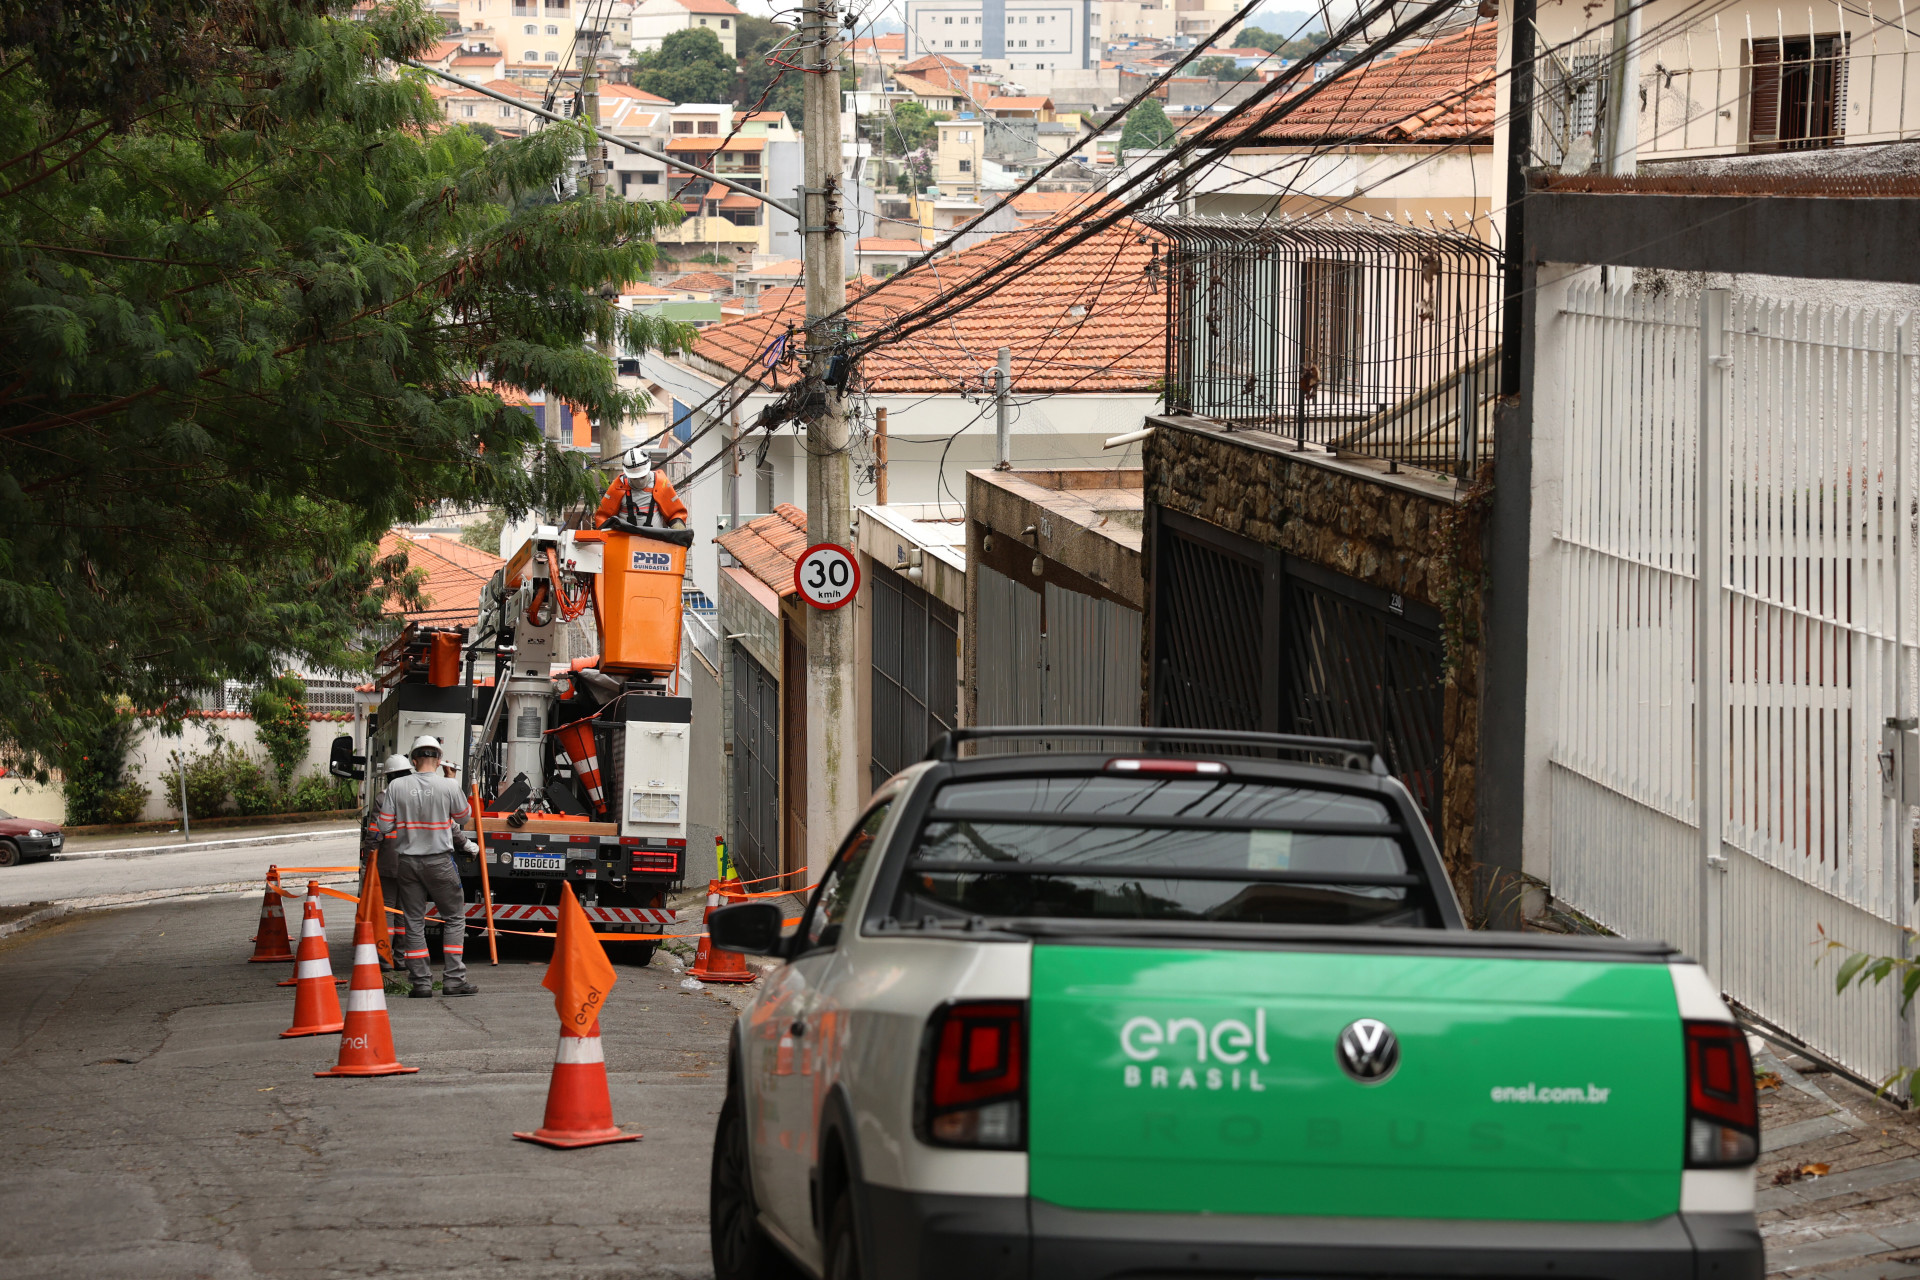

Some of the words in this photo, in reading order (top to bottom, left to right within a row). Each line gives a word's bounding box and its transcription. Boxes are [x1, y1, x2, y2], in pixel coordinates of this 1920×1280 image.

[633, 551, 670, 565] PHD
[808, 559, 849, 589] 30
[818, 590, 841, 598] km/h
[696, 950, 707, 960] nel
[575, 985, 602, 1025] enel
[1120, 1006, 1270, 1064] enel
[1124, 1065, 1266, 1092] BRASIL
[1490, 1081, 1612, 1104] enel.com.br
[1142, 1111, 1583, 1154] ROBUST
